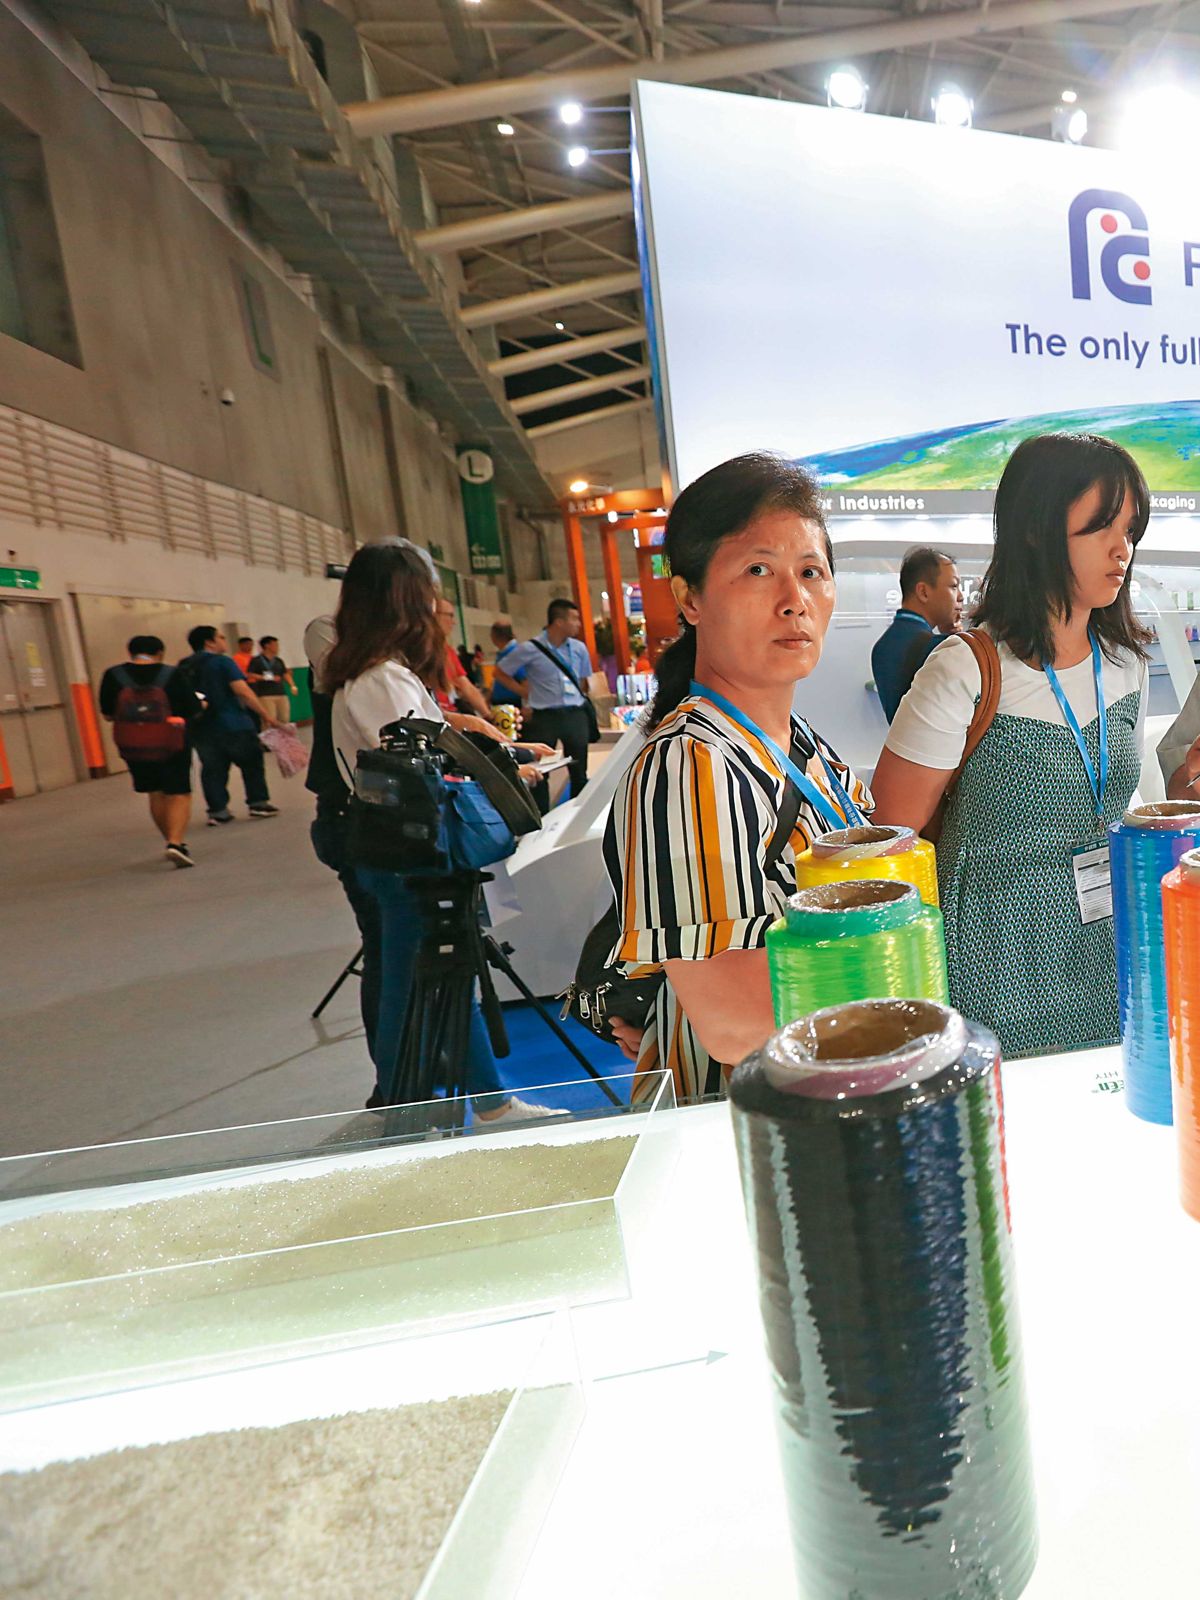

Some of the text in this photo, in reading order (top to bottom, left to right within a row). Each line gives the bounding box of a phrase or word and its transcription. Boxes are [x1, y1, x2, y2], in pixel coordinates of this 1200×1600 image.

[1005, 323, 1067, 357] The
[1080, 331, 1149, 368] only
[840, 495, 925, 510] Industries
[1150, 496, 1196, 510] kaging
